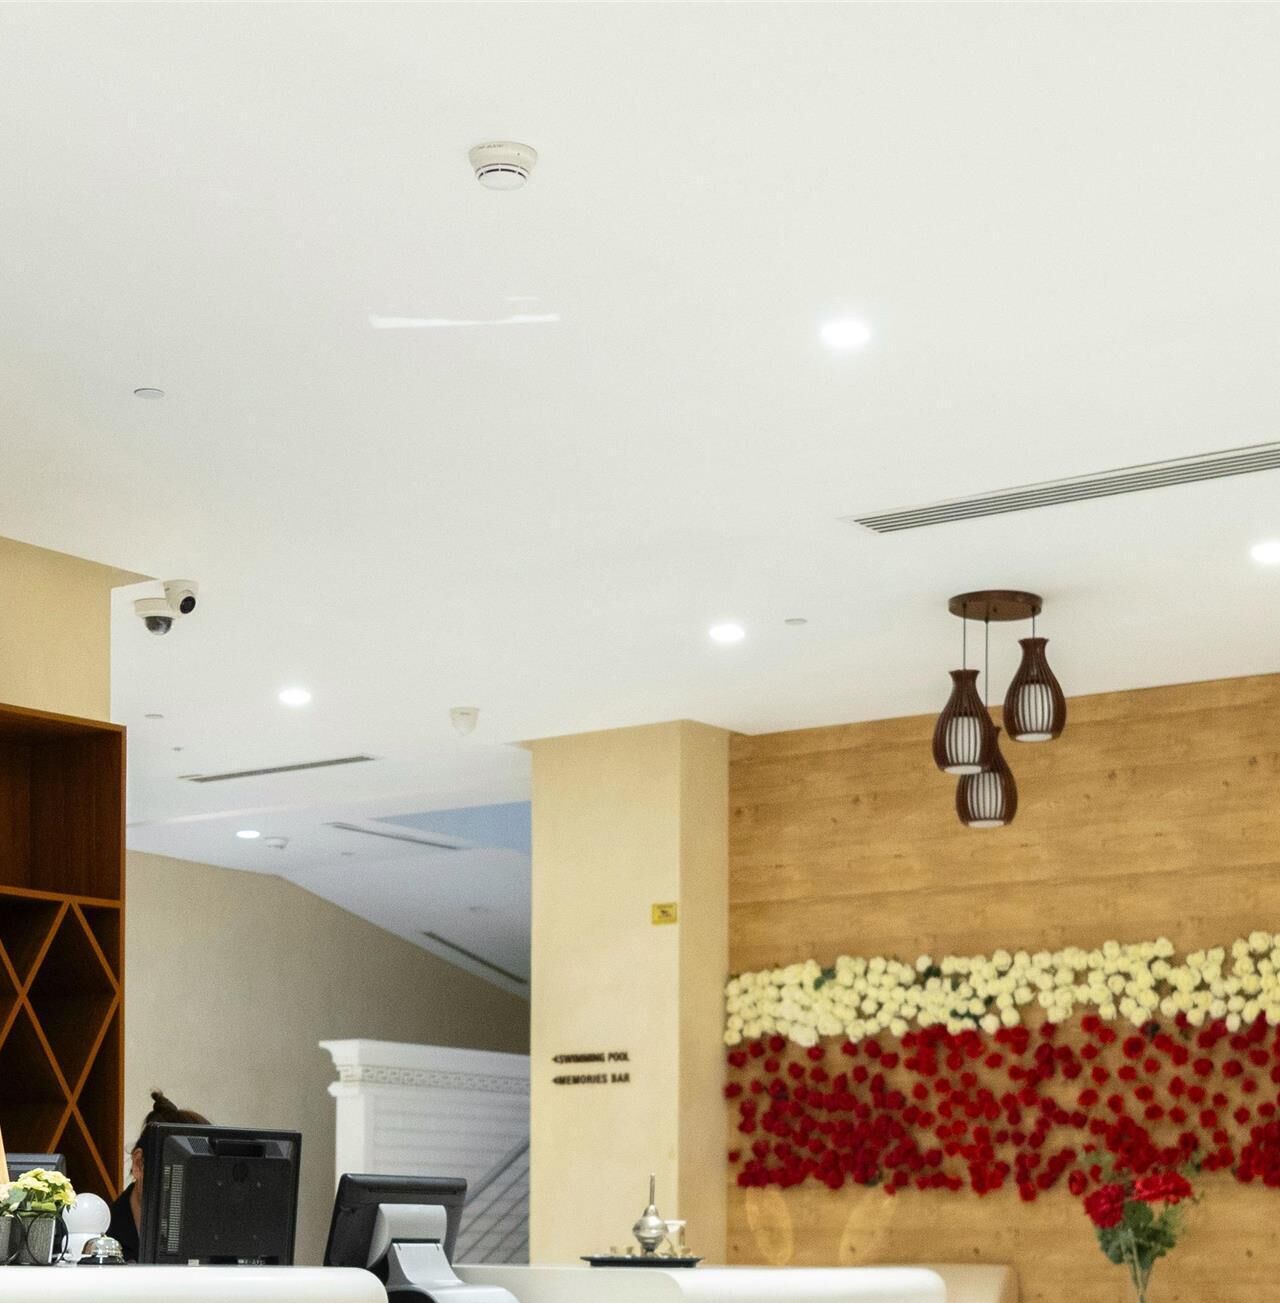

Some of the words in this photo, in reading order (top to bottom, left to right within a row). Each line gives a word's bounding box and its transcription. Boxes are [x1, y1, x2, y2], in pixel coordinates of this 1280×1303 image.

[557, 1052, 605, 1064] SWIMMING
[607, 1051, 629, 1062] POOL
[558, 1073, 608, 1085] MEMORIES
[611, 1072, 630, 1083] BAR
